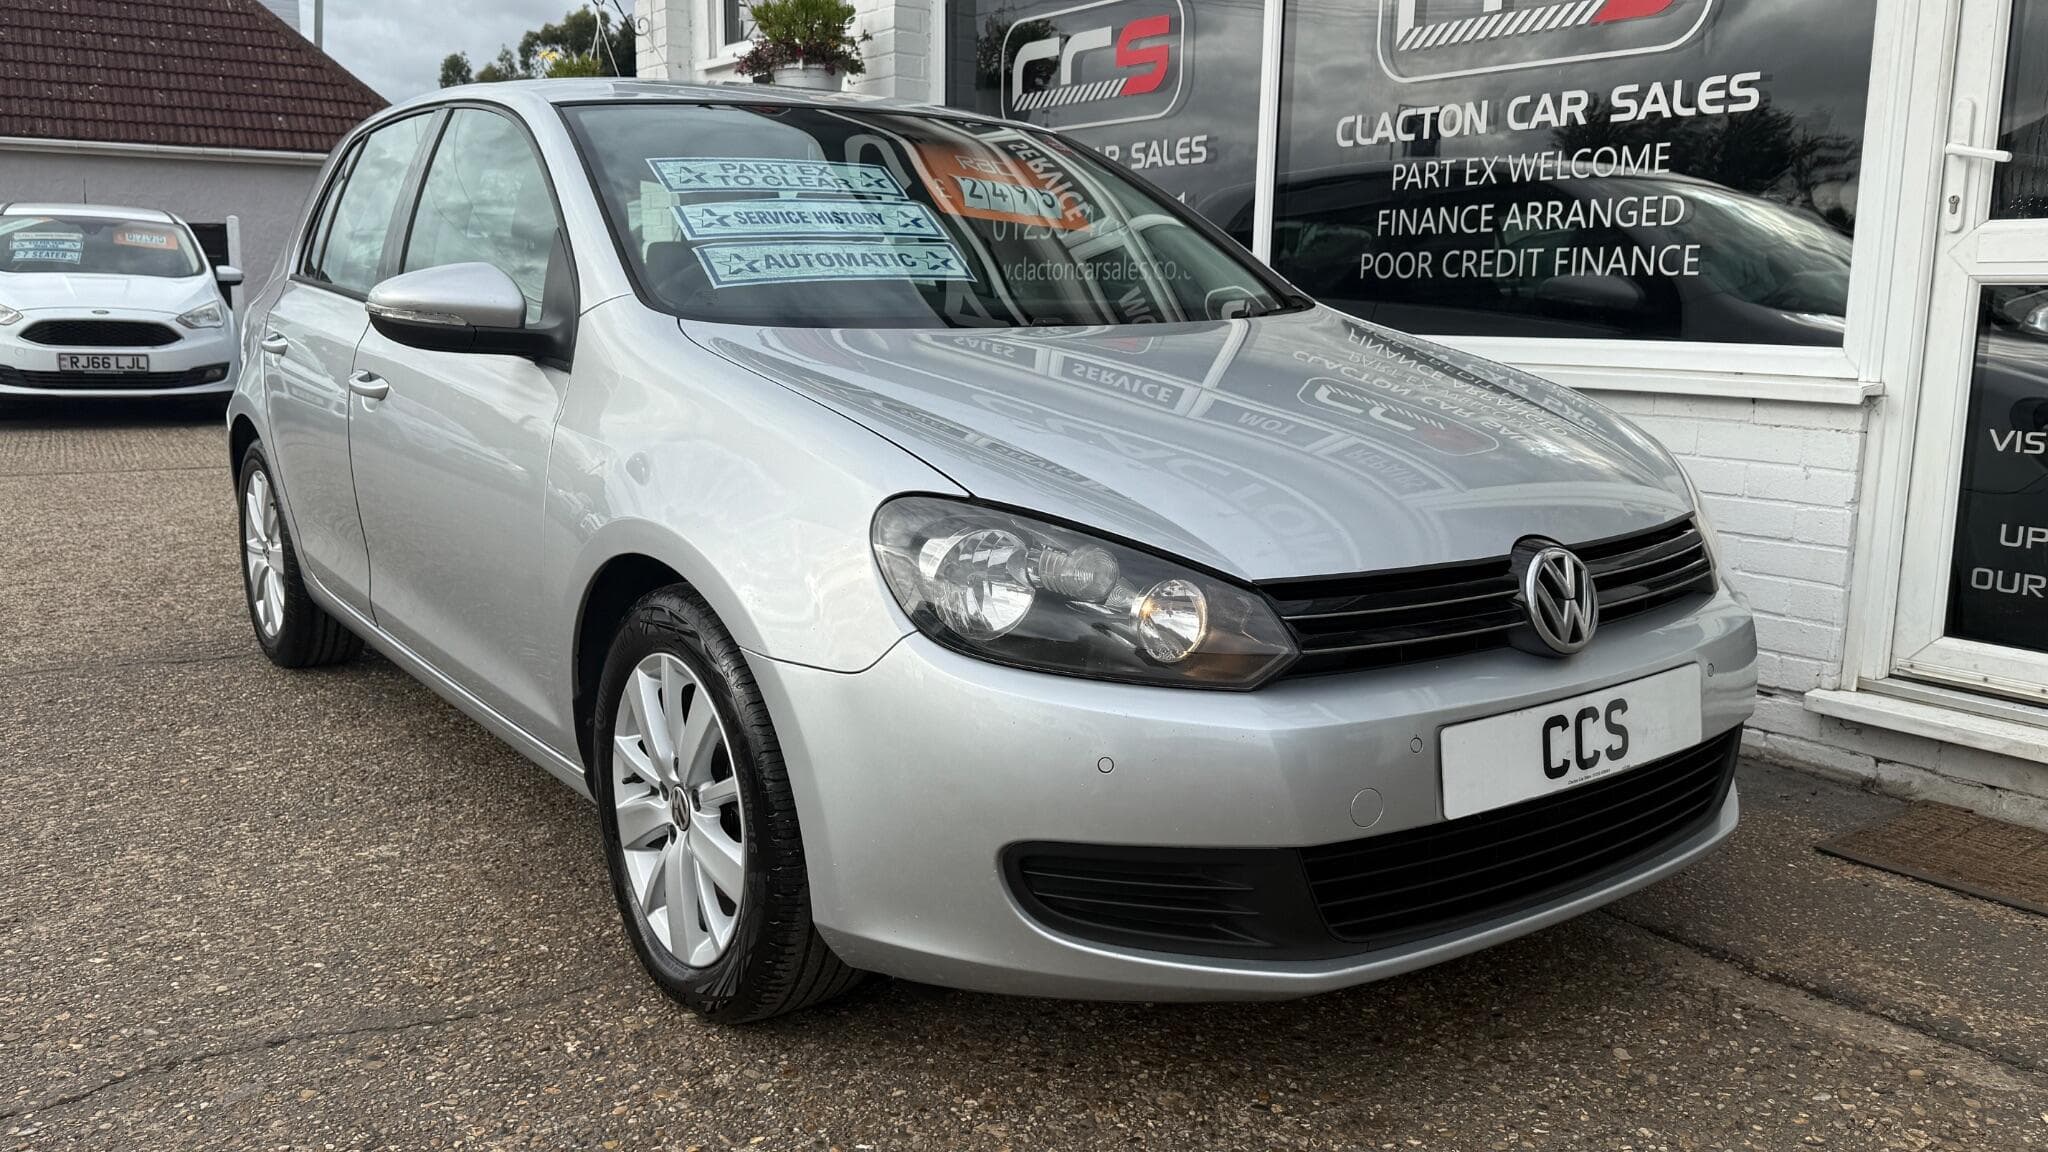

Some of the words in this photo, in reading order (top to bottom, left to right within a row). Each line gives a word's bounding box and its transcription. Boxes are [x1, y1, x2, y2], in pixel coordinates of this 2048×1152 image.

[1336, 100, 1489, 148] CLACTON
[1507, 89, 1590, 132] CAR
[1610, 71, 1763, 123] SALES
[717, 162, 788, 177] PART
[795, 164, 837, 177] EX
[1131, 135, 1208, 170] SALES
[1391, 159, 1456, 191] PART
[1464, 156, 1497, 186] EX
[1508, 142, 1672, 183] WELCOME
[714, 174, 751, 187] TO
[768, 174, 853, 192] CLEAR
[729, 210, 812, 226] SERVICE
[816, 210, 887, 227] HISTORY
[1377, 203, 1495, 237] FINANCE
[1502, 194, 1686, 233] ARRANGED
[763, 252, 918, 271] AUTOMATIC
[1360, 250, 1433, 279] POOR
[1442, 247, 1545, 279] CREDIT
[1554, 244, 1701, 276] FINANCE
[69, 356, 111, 369] RJ66
[115, 356, 146, 370] LJL
[1970, 566, 2048, 599] OUR
[1542, 697, 1630, 780] CCS
